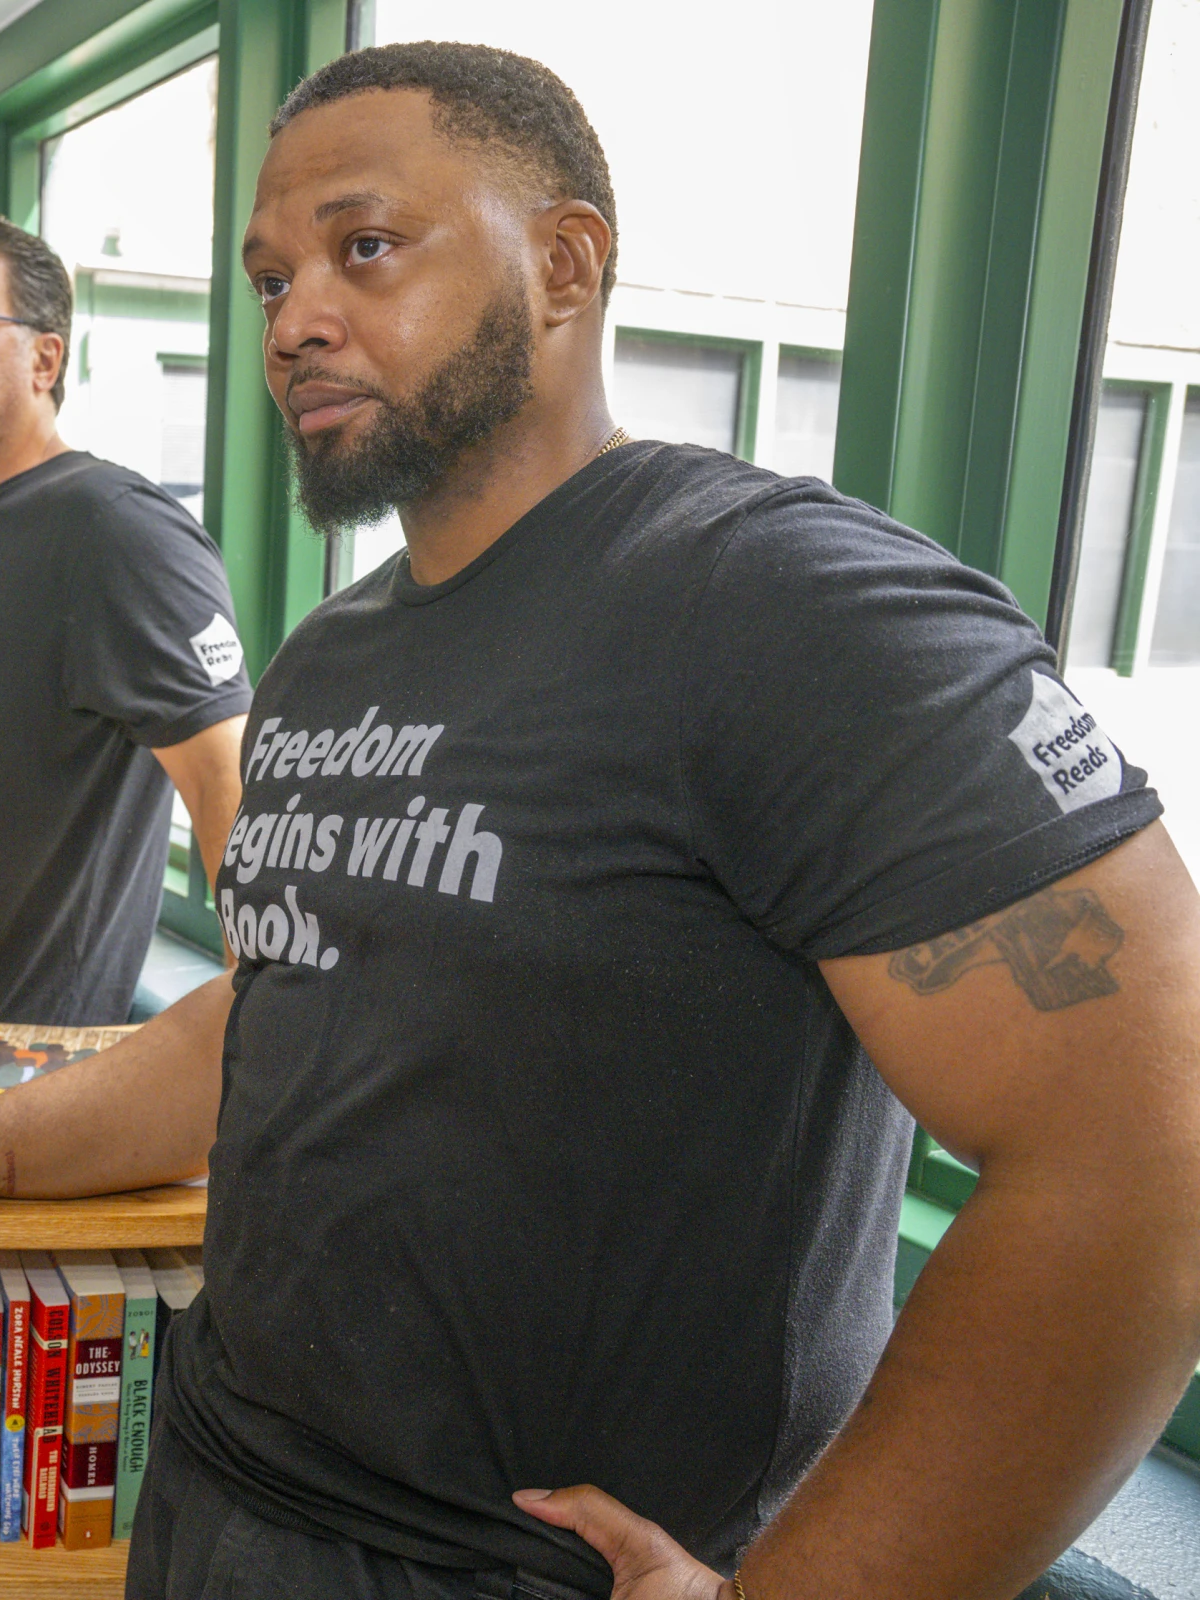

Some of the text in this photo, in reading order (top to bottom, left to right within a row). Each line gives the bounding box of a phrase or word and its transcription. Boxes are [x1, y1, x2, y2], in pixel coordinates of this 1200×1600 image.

[245, 706, 444, 785] Freedom
[1033, 713, 1097, 767] Freedom
[1052, 744, 1107, 794] Reads
[224, 793, 503, 903] egins with
[12, 1306, 24, 1409] ZORA NEALE HURSTON
[42, 1309, 65, 1444] COLSON WHITEHEAD
[76, 1361, 120, 1375] ODYSSEY
[89, 1346, 108, 1359] THE
[129, 1379, 148, 1473] BLACK ENOUGH
[38, 1467, 48, 1500] RAILROAD
[46, 1449, 58, 1512] THE UNDERGROUND
[87, 1446, 98, 1486] HOMER
[2, 1483, 12, 1536] WATCHING GOD
